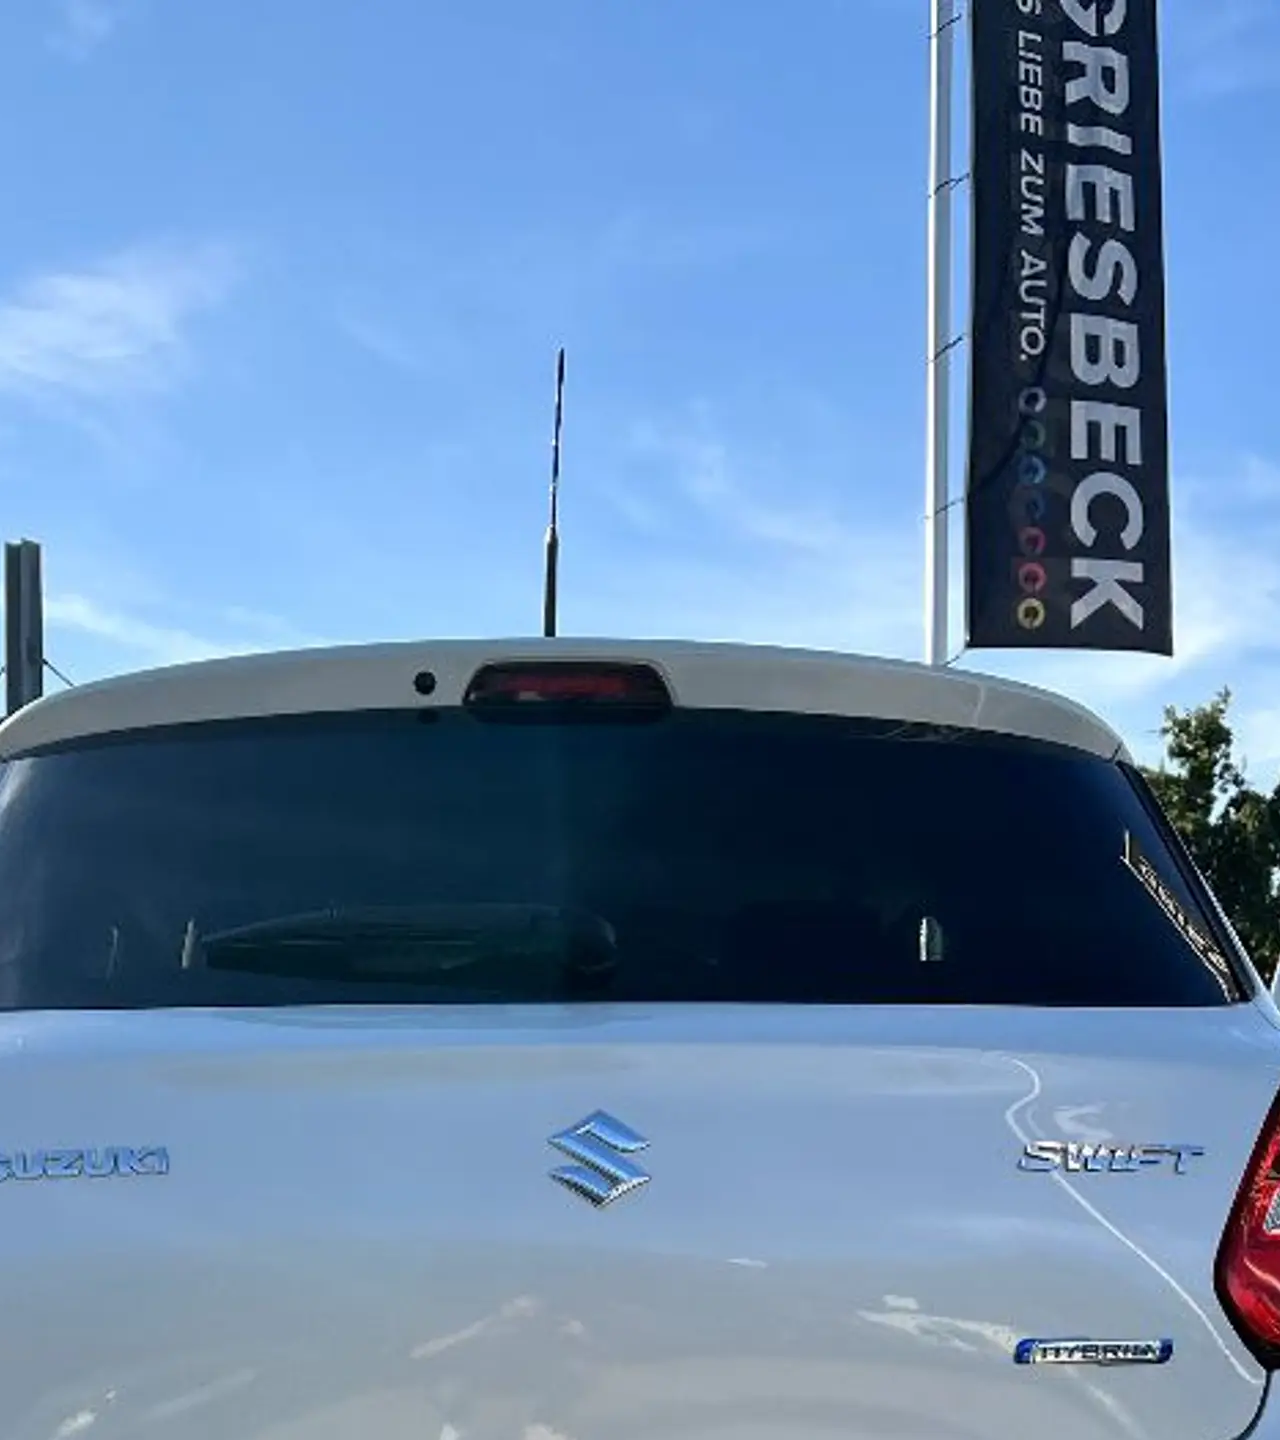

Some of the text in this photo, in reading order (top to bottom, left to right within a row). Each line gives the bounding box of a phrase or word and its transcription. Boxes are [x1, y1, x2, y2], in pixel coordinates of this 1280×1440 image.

[1018, 30, 1043, 136] LIEBE
[1019, 152, 1045, 236] ZUM
[1019, 249, 1047, 361] AUTO.
[1017, 1141, 1205, 1175] SWIFT
